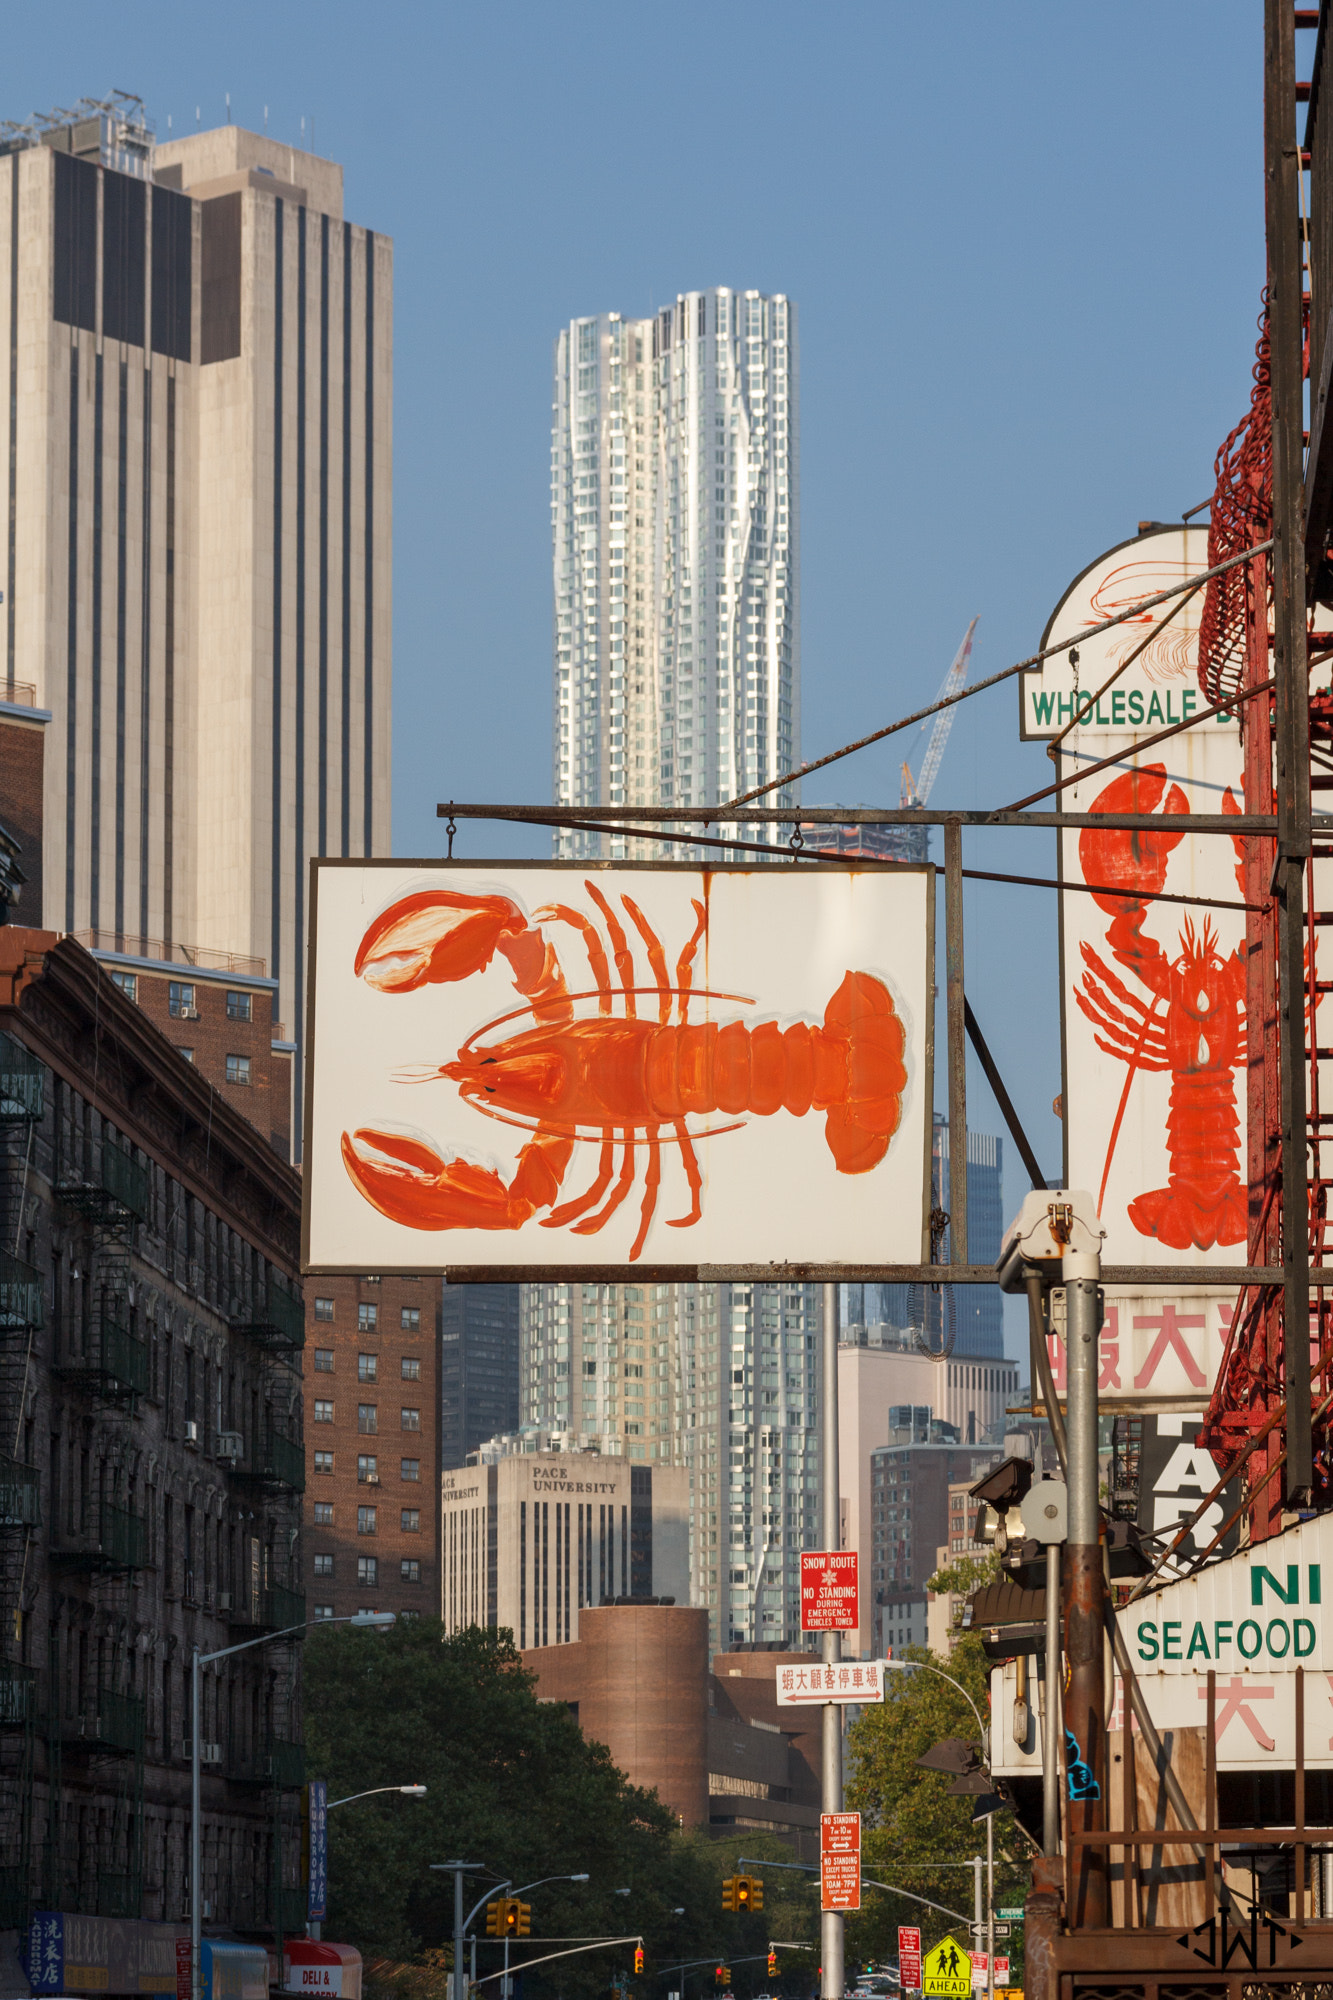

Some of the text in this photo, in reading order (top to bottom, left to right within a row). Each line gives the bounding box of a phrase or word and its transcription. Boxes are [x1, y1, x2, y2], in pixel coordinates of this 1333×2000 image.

[1032, 689, 1196, 726] WHOLESALE
[532, 1466, 568, 1479] PACE
[441, 1477, 456, 1490] ACE
[533, 1480, 616, 1494] UNIVERSITY
[442, 1486, 479, 1503] NIVERSITY
[803, 1556, 856, 1570] SNOW ROUTE
[803, 1586, 856, 1599] NO STANDING
[816, 1599, 843, 1608] DURING
[808, 1608, 851, 1617] EMERGENCY
[807, 1617, 853, 1626] VEHICLES TOWED
[1137, 1618, 1316, 1662] SEAFOOD
[782, 1666, 878, 1691] 蝦大顧客停車場
[824, 1816, 858, 1825] NO STANDING
[309, 1784, 318, 1905] LAUNDROMAT
[824, 1856, 858, 1866] NO STANDING
[825, 1866, 840, 1874] EXCEPT
[30, 1916, 42, 1986] LAUNDROMAT
[42, 1918, 62, 1984] 洗衣店
[302, 1970, 330, 1985] DELI &
[929, 1980, 966, 1992] AHEAD
